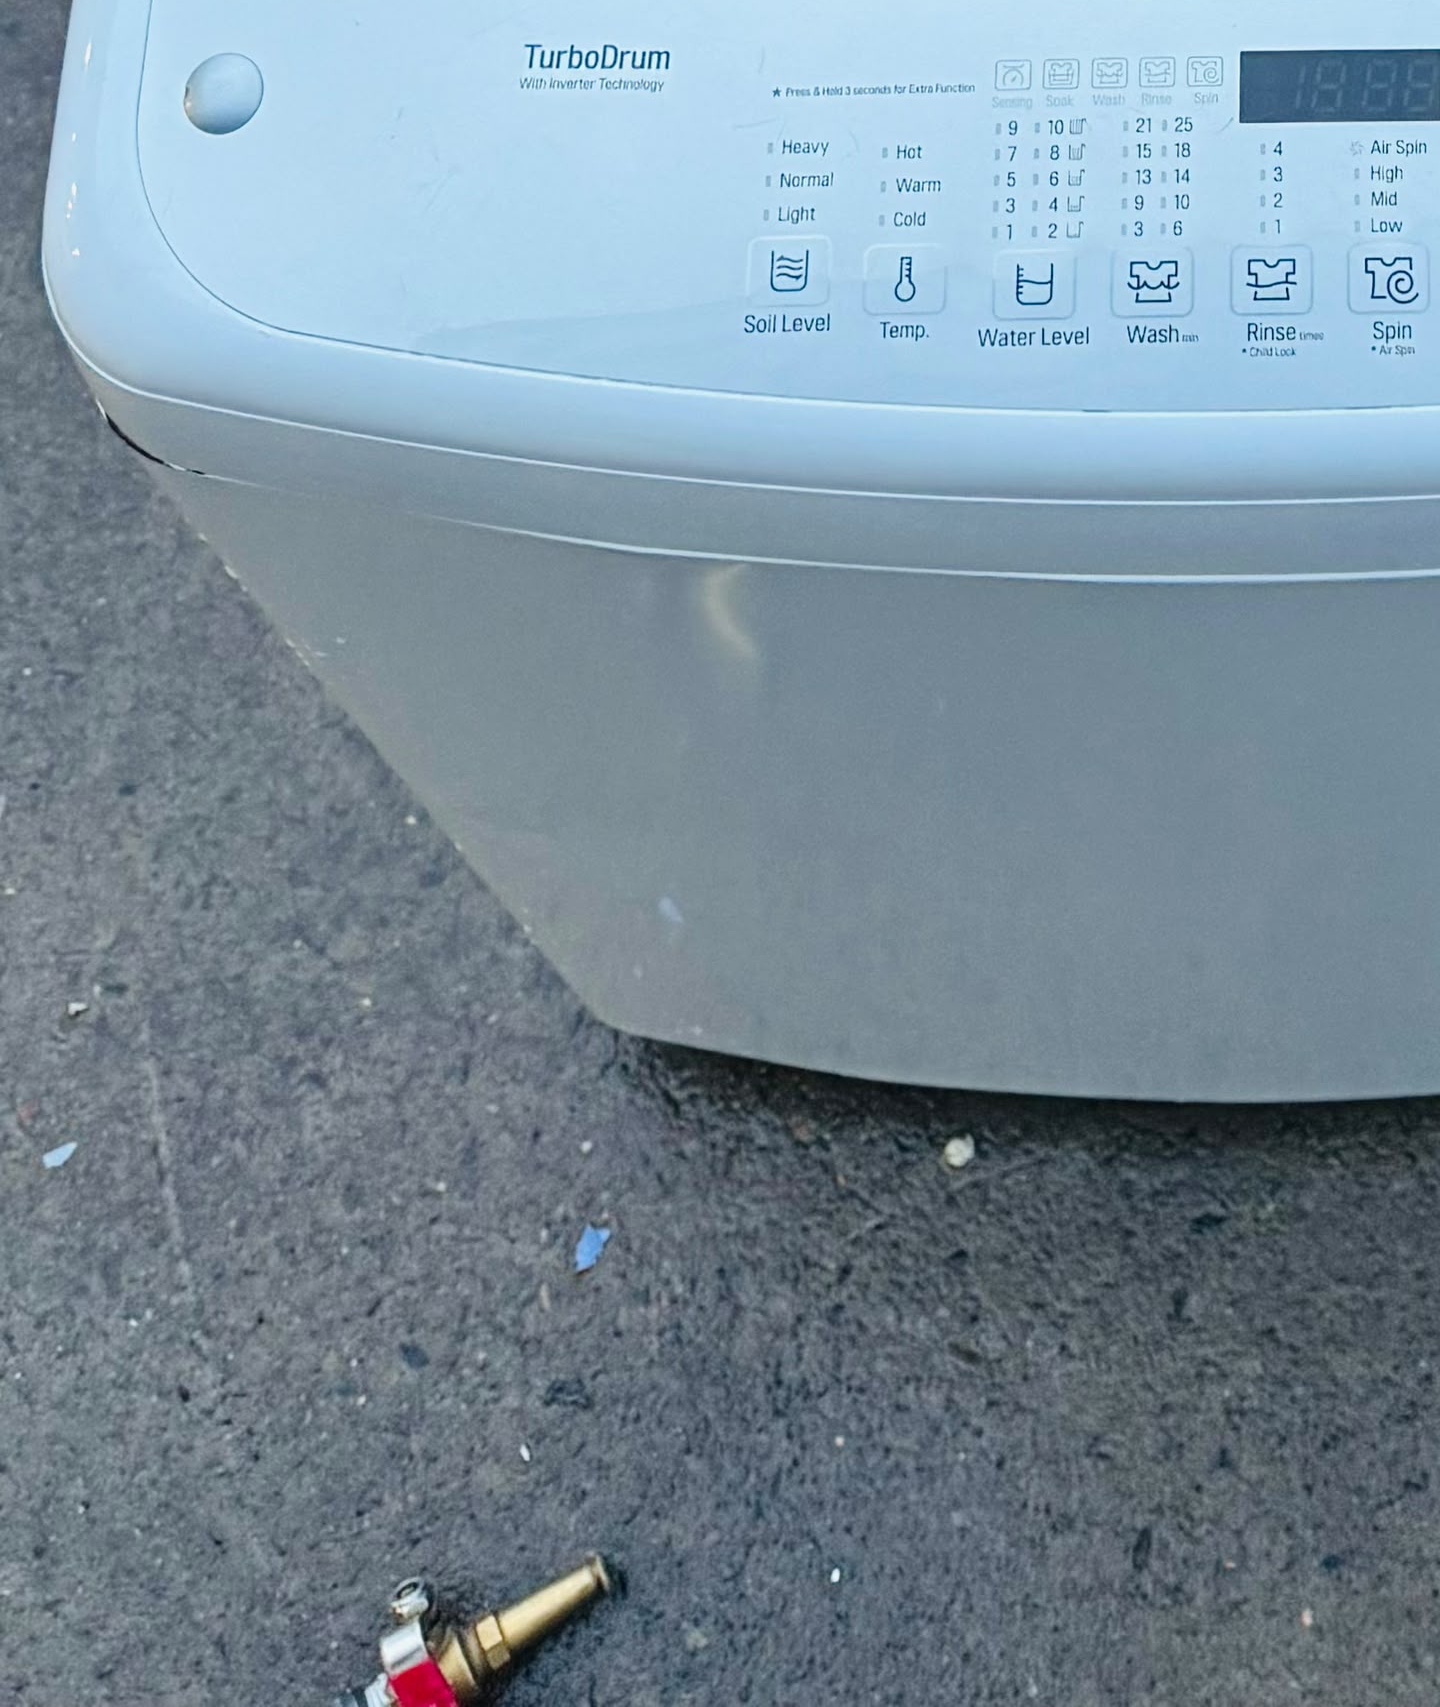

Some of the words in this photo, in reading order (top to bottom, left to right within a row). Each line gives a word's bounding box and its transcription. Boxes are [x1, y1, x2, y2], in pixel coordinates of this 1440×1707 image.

[524, 43, 671, 70] TurboDrum
[519, 76, 547, 90] With
[548, 77, 597, 91] Inverter
[598, 77, 665, 93] Technology
[1194, 91, 1219, 105] Spin
[1008, 120, 1018, 136] 9
[1047, 119, 1064, 136] 10
[1135, 117, 1152, 134] 21
[1174, 116, 1194, 133] 25
[781, 139, 830, 158] Heavy
[896, 144, 923, 160] Hot
[1007, 145, 1017, 162] 7
[1049, 144, 1060, 161] 8
[1136, 142, 1152, 159] 15
[1174, 142, 1191, 158] 18
[1273, 140, 1283, 156] 4
[1370, 139, 1392, 155] Air
[1395, 139, 1427, 158] Spin
[779, 171, 834, 188] Normal
[1006, 171, 1017, 188] 5
[1049, 170, 1059, 187] 6
[1135, 168, 1152, 185] 13
[1174, 168, 1190, 184] 14
[1273, 165, 1283, 183] 3
[1370, 165, 1404, 184] High
[895, 177, 942, 193] Warm
[1005, 197, 1016, 214] 3
[1048, 196, 1058, 212] 4
[1134, 194, 1145, 211] 9
[1174, 194, 1190, 210] 10
[1273, 192, 1283, 209] 2
[1370, 190, 1398, 207] Mid
[777, 206, 816, 225] Light
[893, 211, 927, 228] Cold
[1006, 223, 1013, 241] 1
[1047, 222, 1058, 239] 2
[1133, 220, 1144, 237] 3
[1173, 220, 1183, 237] 6
[1274, 218, 1281, 235] 1
[1370, 217, 1403, 233] Low
[743, 314, 777, 334] Soil
[781, 312, 831, 333] Level
[879, 321, 930, 342] Temp.
[977, 328, 1037, 348] Water
[1041, 326, 1090, 346] Level
[1126, 323, 1180, 344] Wash
[1247, 322, 1297, 342] Rinse
[1372, 320, 1412, 344] Spin
